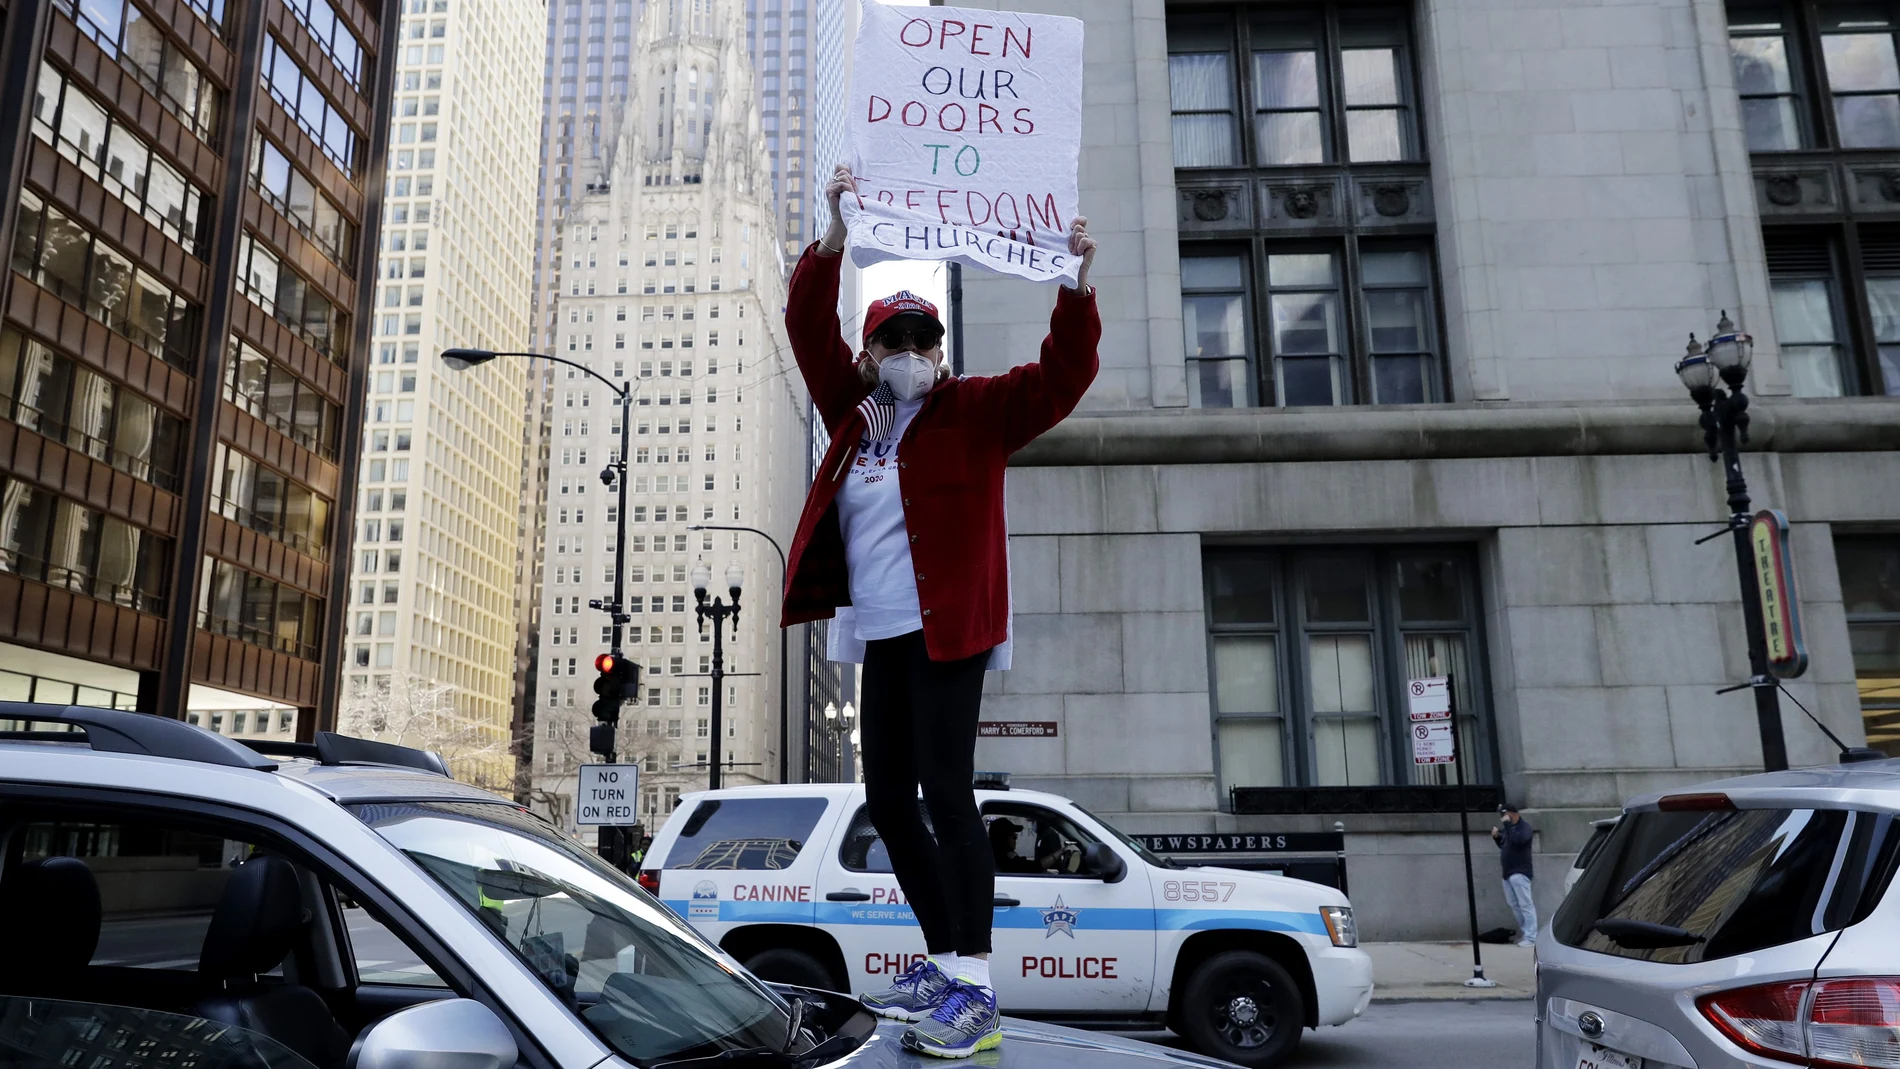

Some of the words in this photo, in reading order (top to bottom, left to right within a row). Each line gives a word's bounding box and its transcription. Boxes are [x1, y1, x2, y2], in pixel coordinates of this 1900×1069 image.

[900, 18, 1032, 58] OPEN
[922, 66, 1019, 100] OUR
[868, 95, 1034, 134] DOORS
[923, 144, 980, 176] TO
[872, 222, 1065, 274] CHURCHES
[859, 439, 900, 458] RU
[865, 475, 884, 483] 2020
[1758, 539, 1781, 653] THEATRE
[981, 727, 1000, 735] HARRY
[1002, 727, 1008, 735] G.
[1009, 727, 1044, 735] COMERFORD
[598, 771, 618, 783] NO
[591, 788, 624, 800] TURN
[583, 806, 600, 817] ON
[606, 806, 631, 817] RED
[1136, 835, 1287, 850] NEWSPAPERS
[733, 884, 811, 902] CANINE
[872, 887, 908, 905] PA
[1163, 880, 1237, 902] 8557
[852, 910, 866, 918] WE
[867, 911, 895, 919] SERVE
[897, 911, 914, 919] AND
[1045, 913, 1074, 923] CAPS
[1022, 956, 1118, 979] POLICE
